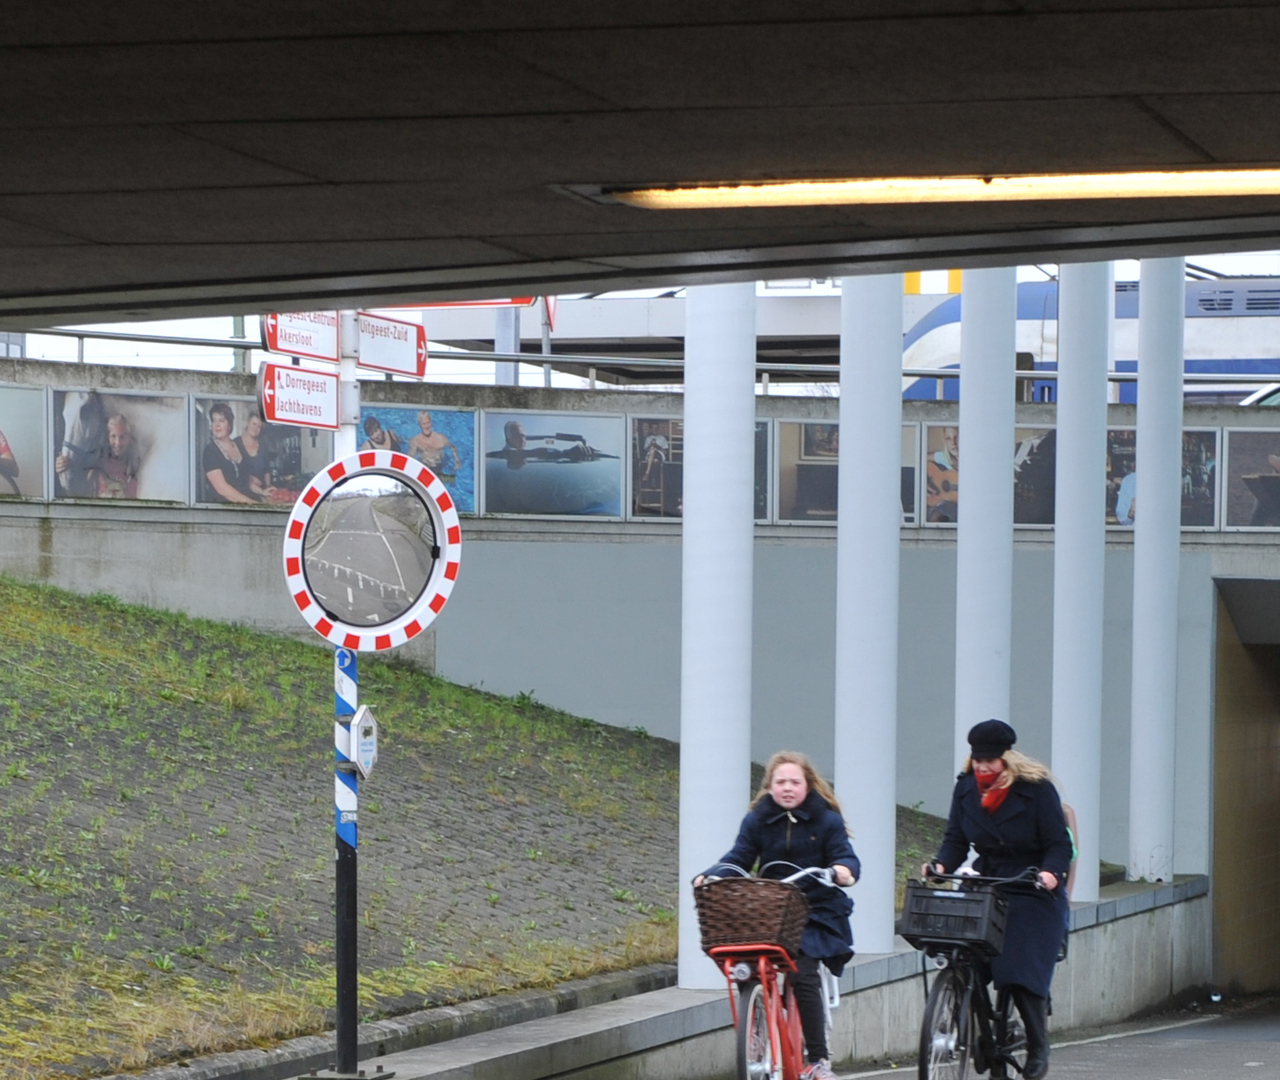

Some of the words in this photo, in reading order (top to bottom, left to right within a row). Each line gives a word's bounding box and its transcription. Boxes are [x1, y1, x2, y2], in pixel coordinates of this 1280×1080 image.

[279, 328, 312, 346] Akersloot
[360, 319, 408, 341] Uitgeest-Zuid
[286, 373, 326, 394] Dorregeest
[277, 397, 321, 416] Jachthavens
